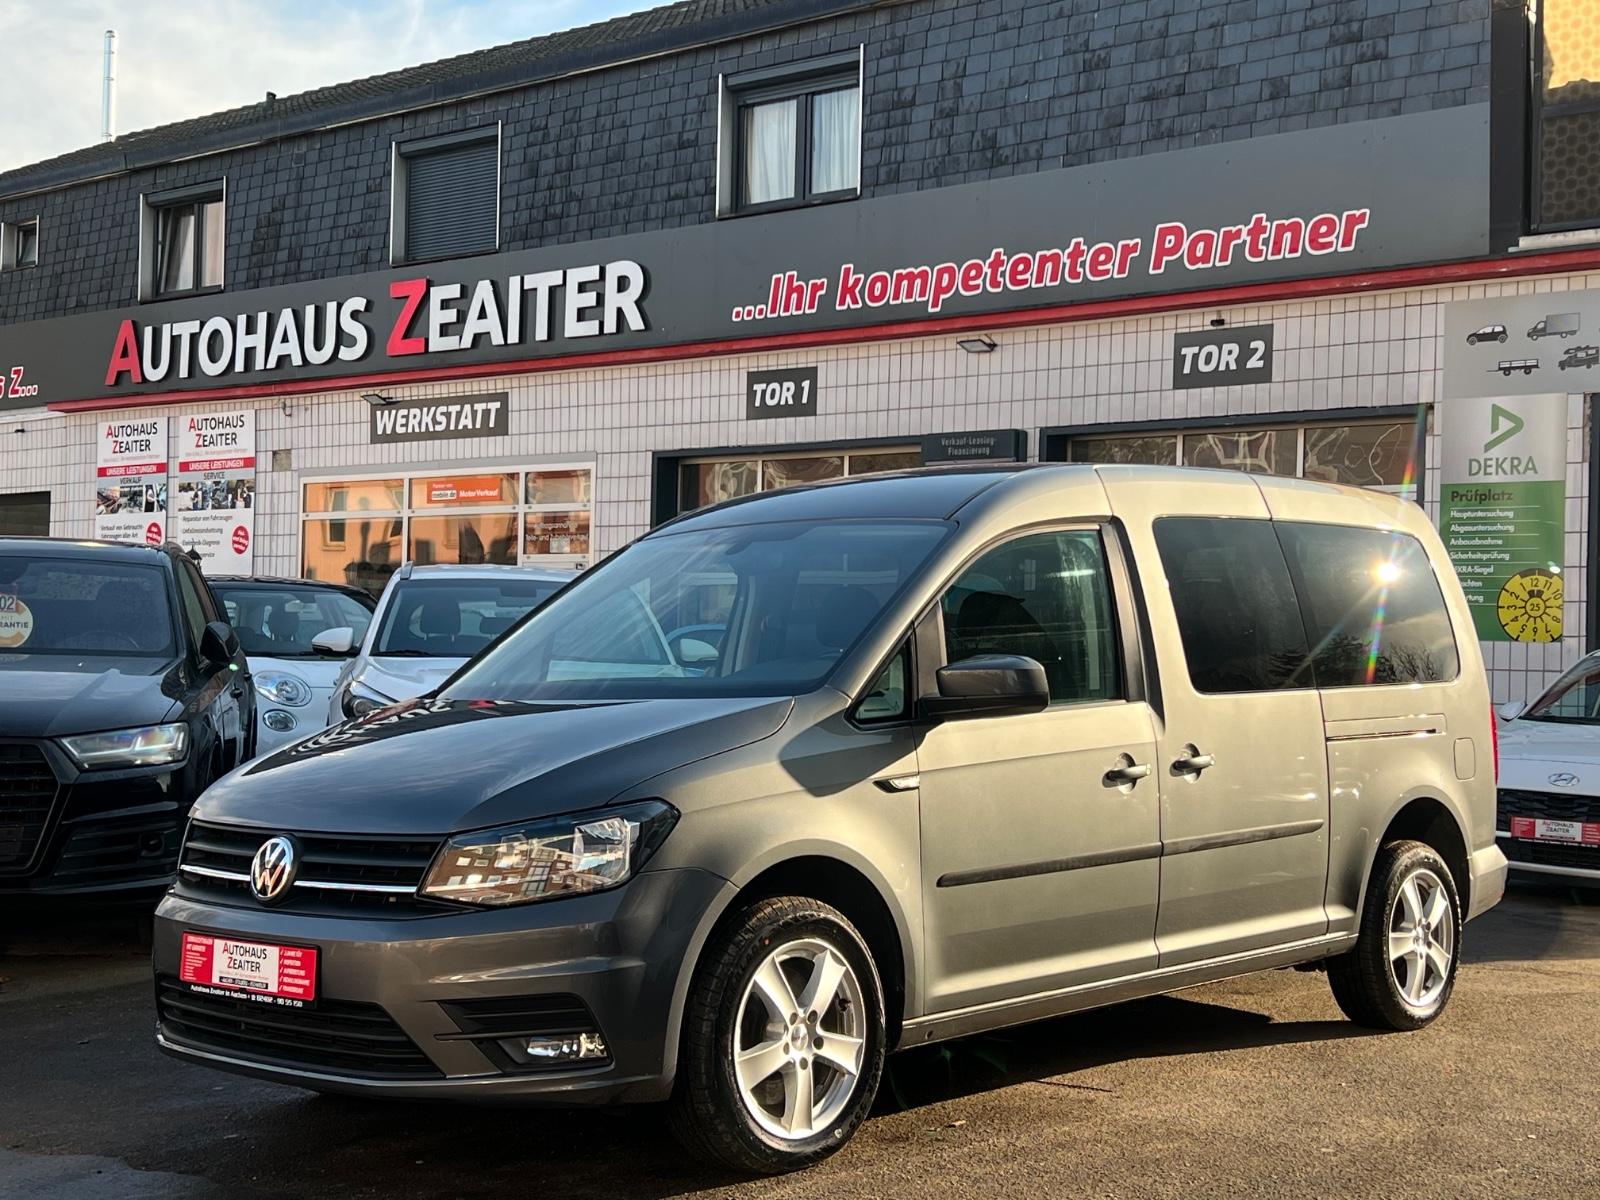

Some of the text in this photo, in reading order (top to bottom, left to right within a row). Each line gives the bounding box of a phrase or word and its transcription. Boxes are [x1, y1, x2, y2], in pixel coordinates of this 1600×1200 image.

[732, 208, 1370, 322] ...Ihr kompetenter Partner
[105, 260, 646, 386] AUTOHAUS ZEAITER
[1181, 340, 1266, 374] TOR 2
[753, 380, 810, 407] TOR 1
[188, 415, 245, 432] AUTOHAUS
[375, 401, 501, 435] WERKSTATT
[106, 422, 158, 439] AUTOHAUS
[112, 439, 151, 454] ZEAITER
[195, 432, 237, 448] ZEAITER
[948, 446, 990, 456] Finanzierung
[106, 465, 157, 475] UNSERE LEISTUNGEN
[189, 459, 244, 471] UNSERE LEISTUNGEN
[1468, 455, 1538, 477] DEKRA
[120, 477, 142, 485] VERKAUF
[203, 472, 225, 480] SERVICE
[1451, 489, 1513, 504] Prüfplatz
[1450, 509, 1514, 519] Hauptuntersuchung
[1450, 523, 1515, 533] Abgasuntersuchung
[1450, 537, 1503, 546] Anbauabnahme
[1450, 550, 1510, 561] Sicherheitsprüfung
[1530, 577, 1539, 588] 12
[1529, 603, 1541, 611] 25
[223, 942, 267, 960] AUTOHAUS
[227, 956, 260, 972] ZEAITER
